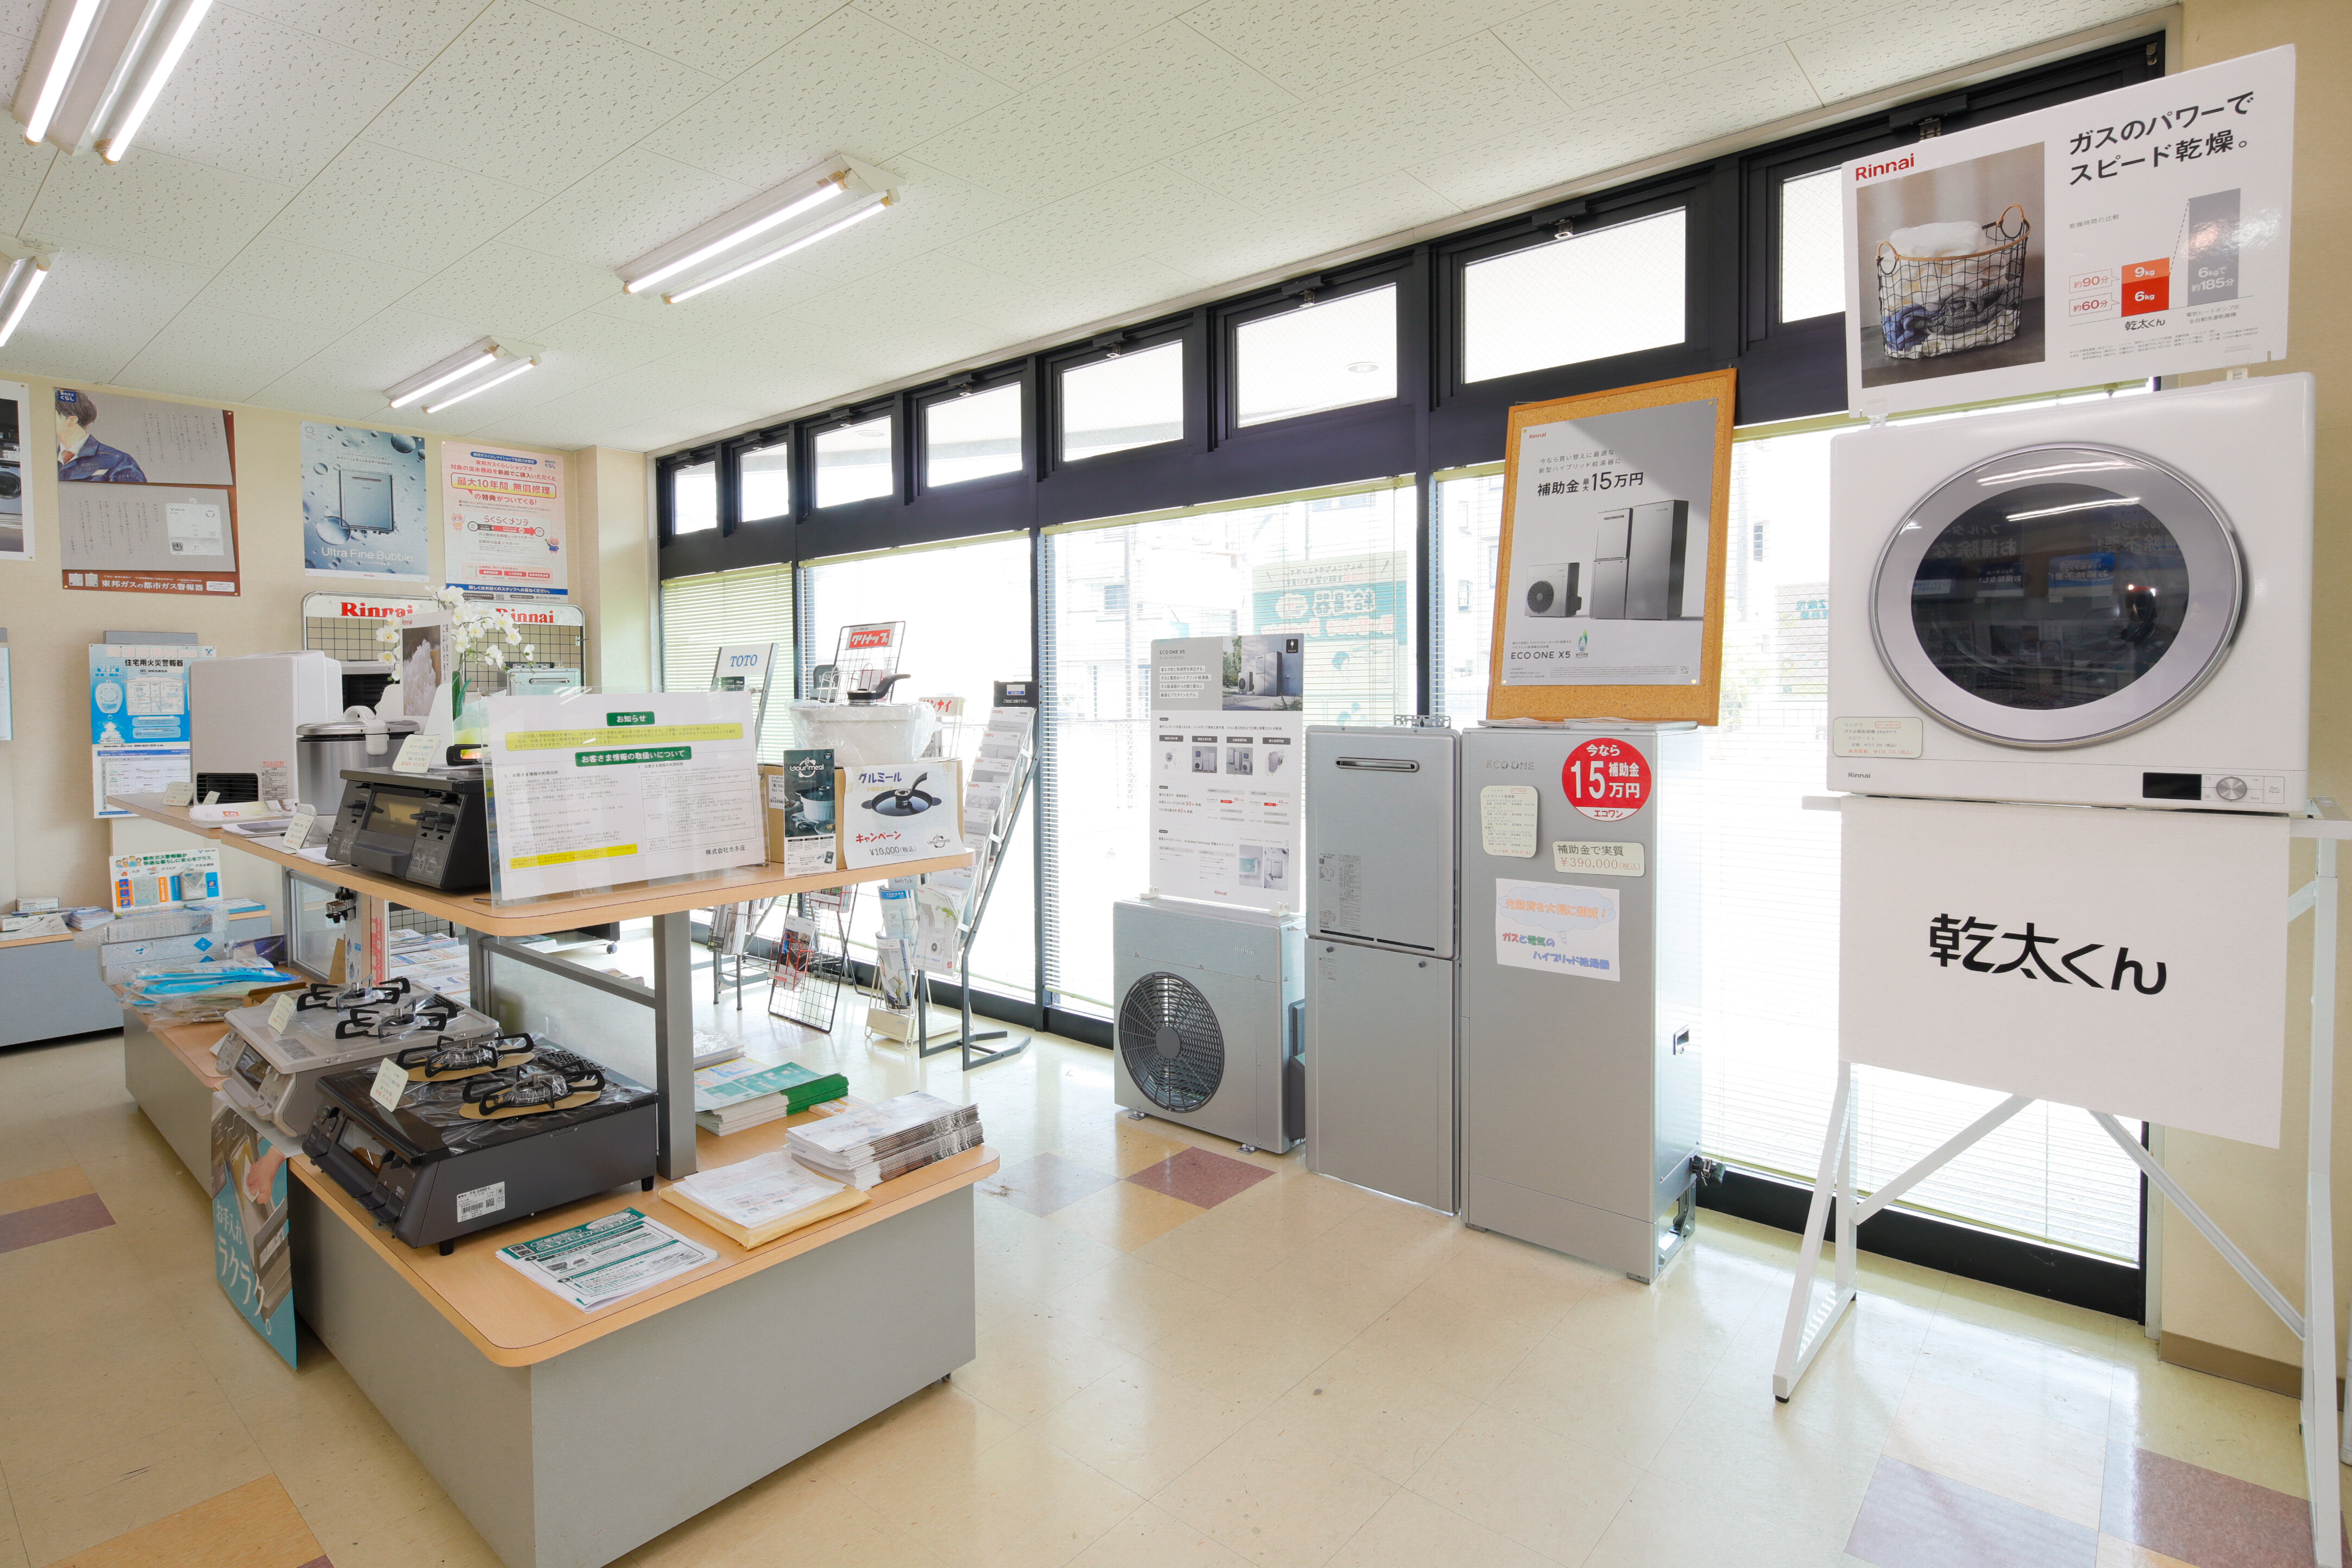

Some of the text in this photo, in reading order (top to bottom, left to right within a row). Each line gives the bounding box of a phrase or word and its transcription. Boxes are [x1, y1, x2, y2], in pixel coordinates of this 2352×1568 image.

[2070, 91, 2254, 155] ガスのパワーで
[2070, 129, 2248, 185] スピード乾燥。
[1855, 153, 1915, 181] Rinnai
[2069, 214, 2120, 229] 乾燥時間の比較
[2135, 267, 2155, 278] 9kg
[2198, 266, 2227, 278] 6kgで
[2073, 275, 2109, 289] 約90分
[2191, 278, 2235, 292] 約185分
[2134, 291, 2155, 302] 6kg
[2073, 300, 2108, 312] 約60分
[2124, 318, 2166, 331] 乾太くん
[1540, 449, 1614, 464] 今なら買い替えに最適な
[476, 460, 533, 471] 東邦ガスくらしショップで
[1539, 458, 1621, 474] 新型ハイブリッド給湯器に
[450, 464, 556, 481] 対象の温水機器を新規でご購入いただくと
[457, 476, 551, 495] 最大10年間 無償修理
[475, 493, 537, 506] の特典がついてくる!
[484, 515, 530, 526] らくらくメンテ
[322, 546, 413, 562] Ultra Fine Bubble
[101, 580, 204, 591] 東邦ガスの都市ガス警報器
[341, 602, 413, 618] Rinnai
[851, 632, 888, 645] クリナップ
[124, 659, 184, 667] 住宅用火災警報器
[730, 654, 758, 667] TOTO
[617, 714, 646, 723] お知らせ
[581, 750, 686, 764] お客さま情報の取扱いについて
[1586, 744, 1621, 757] 今なら
[1486, 760, 1535, 770] ECO ONE
[1609, 762, 1640, 777] 補助金
[859, 772, 902, 784] グルミール
[1571, 760, 1606, 799] 15
[1609, 783, 1640, 798] 万円
[1594, 809, 1624, 818] エコワン
[856, 831, 902, 843] キャンペーン
[143, 853, 187, 861] 都市ガス警報器が
[706, 845, 746, 856] 株式会社カネ庄
[1557, 844, 1625, 857] 補助金で実質
[143, 855, 214, 866] 快適な暮らしに安心をプラス。
[1506, 898, 1608, 919] 光熱費を大幅に削減！
[1502, 932, 1556, 947] ガスと電気の
[1532, 950, 1610, 970] ハイブリッド給湯器
[1929, 912, 2167, 995] 乾太くん
[217, 1199, 243, 1245] お手入れ
